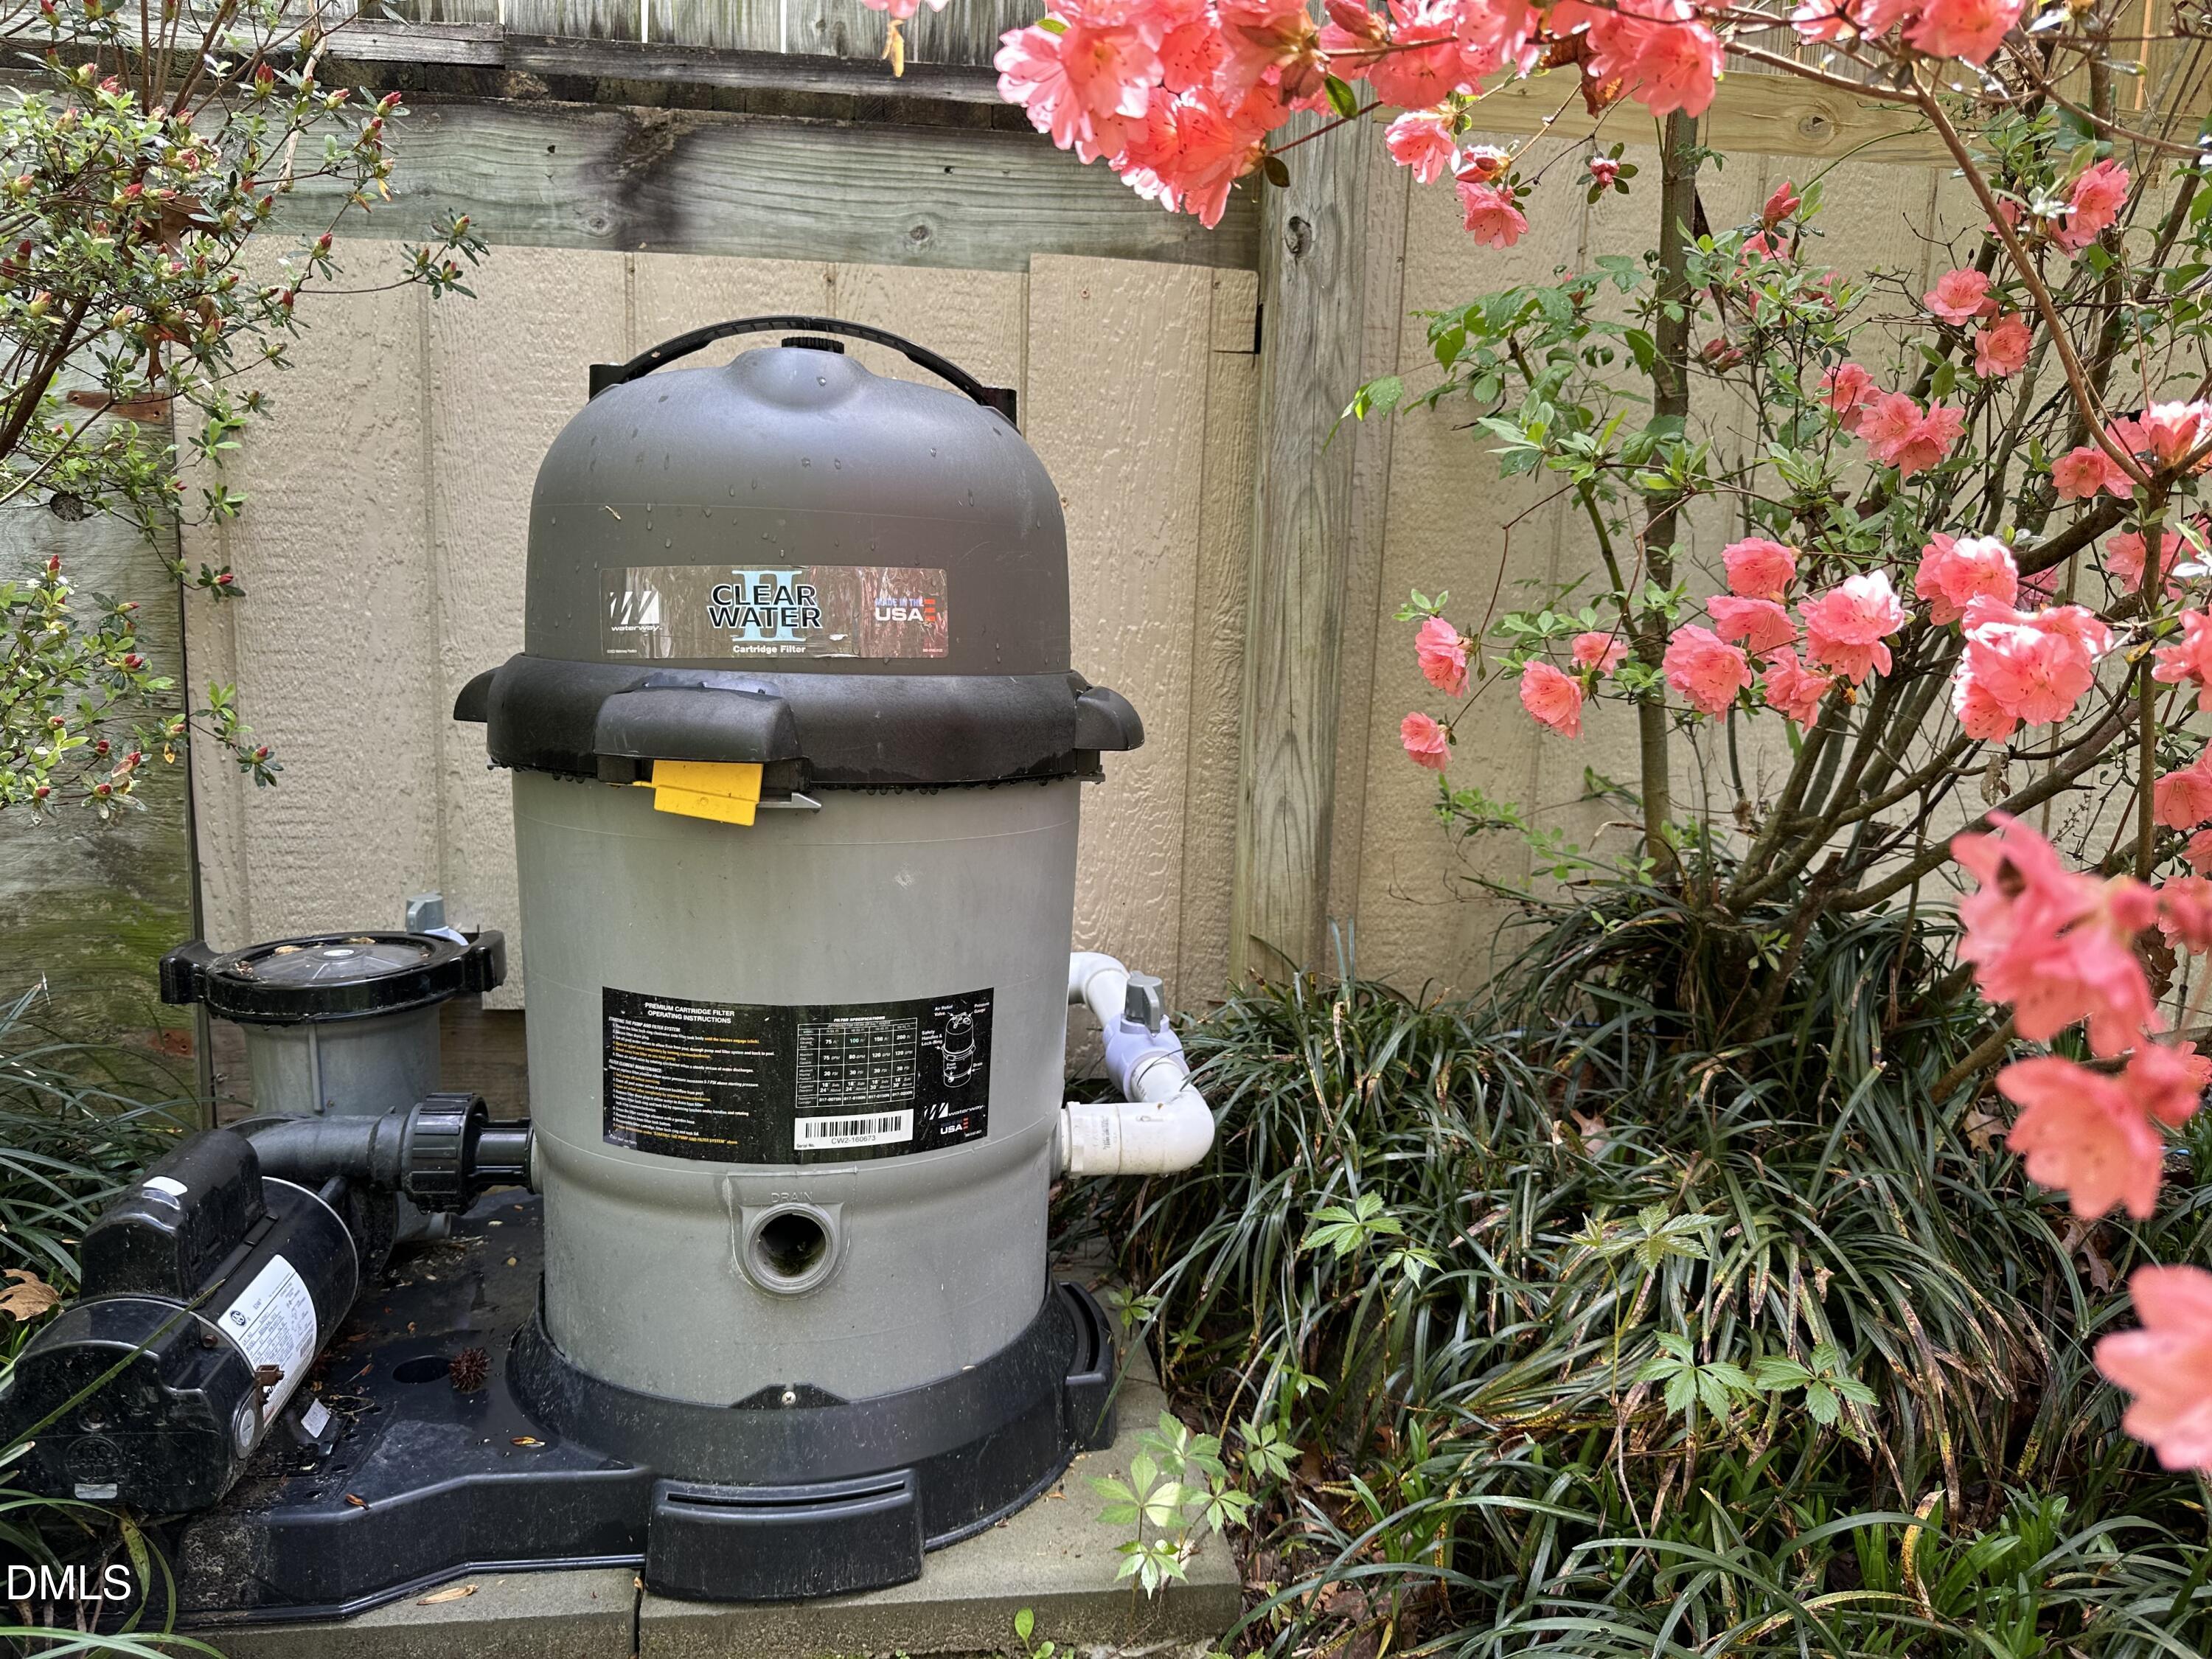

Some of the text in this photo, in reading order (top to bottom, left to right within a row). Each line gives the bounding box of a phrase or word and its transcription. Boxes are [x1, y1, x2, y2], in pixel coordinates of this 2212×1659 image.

[712, 584, 818, 606] CLEAR
[875, 598, 897, 607] MADE
[900, 598, 907, 607] IN
[707, 606, 823, 628] WATER
[875, 608, 924, 622] USA
[733, 645, 806, 655] Cartridge Filter
[645, 1002, 674, 1011] PREMIUM
[675, 1006, 711, 1015] CARTRIDGE
[648, 1010, 731, 1023] OPERATING INSTRUCTIONS
[948, 1105, 984, 1116] waterway
[941, 1124, 963, 1135] USA
[832, 1135, 876, 1144] CW2-160673
[771, 1192, 813, 1203] DRAIN
